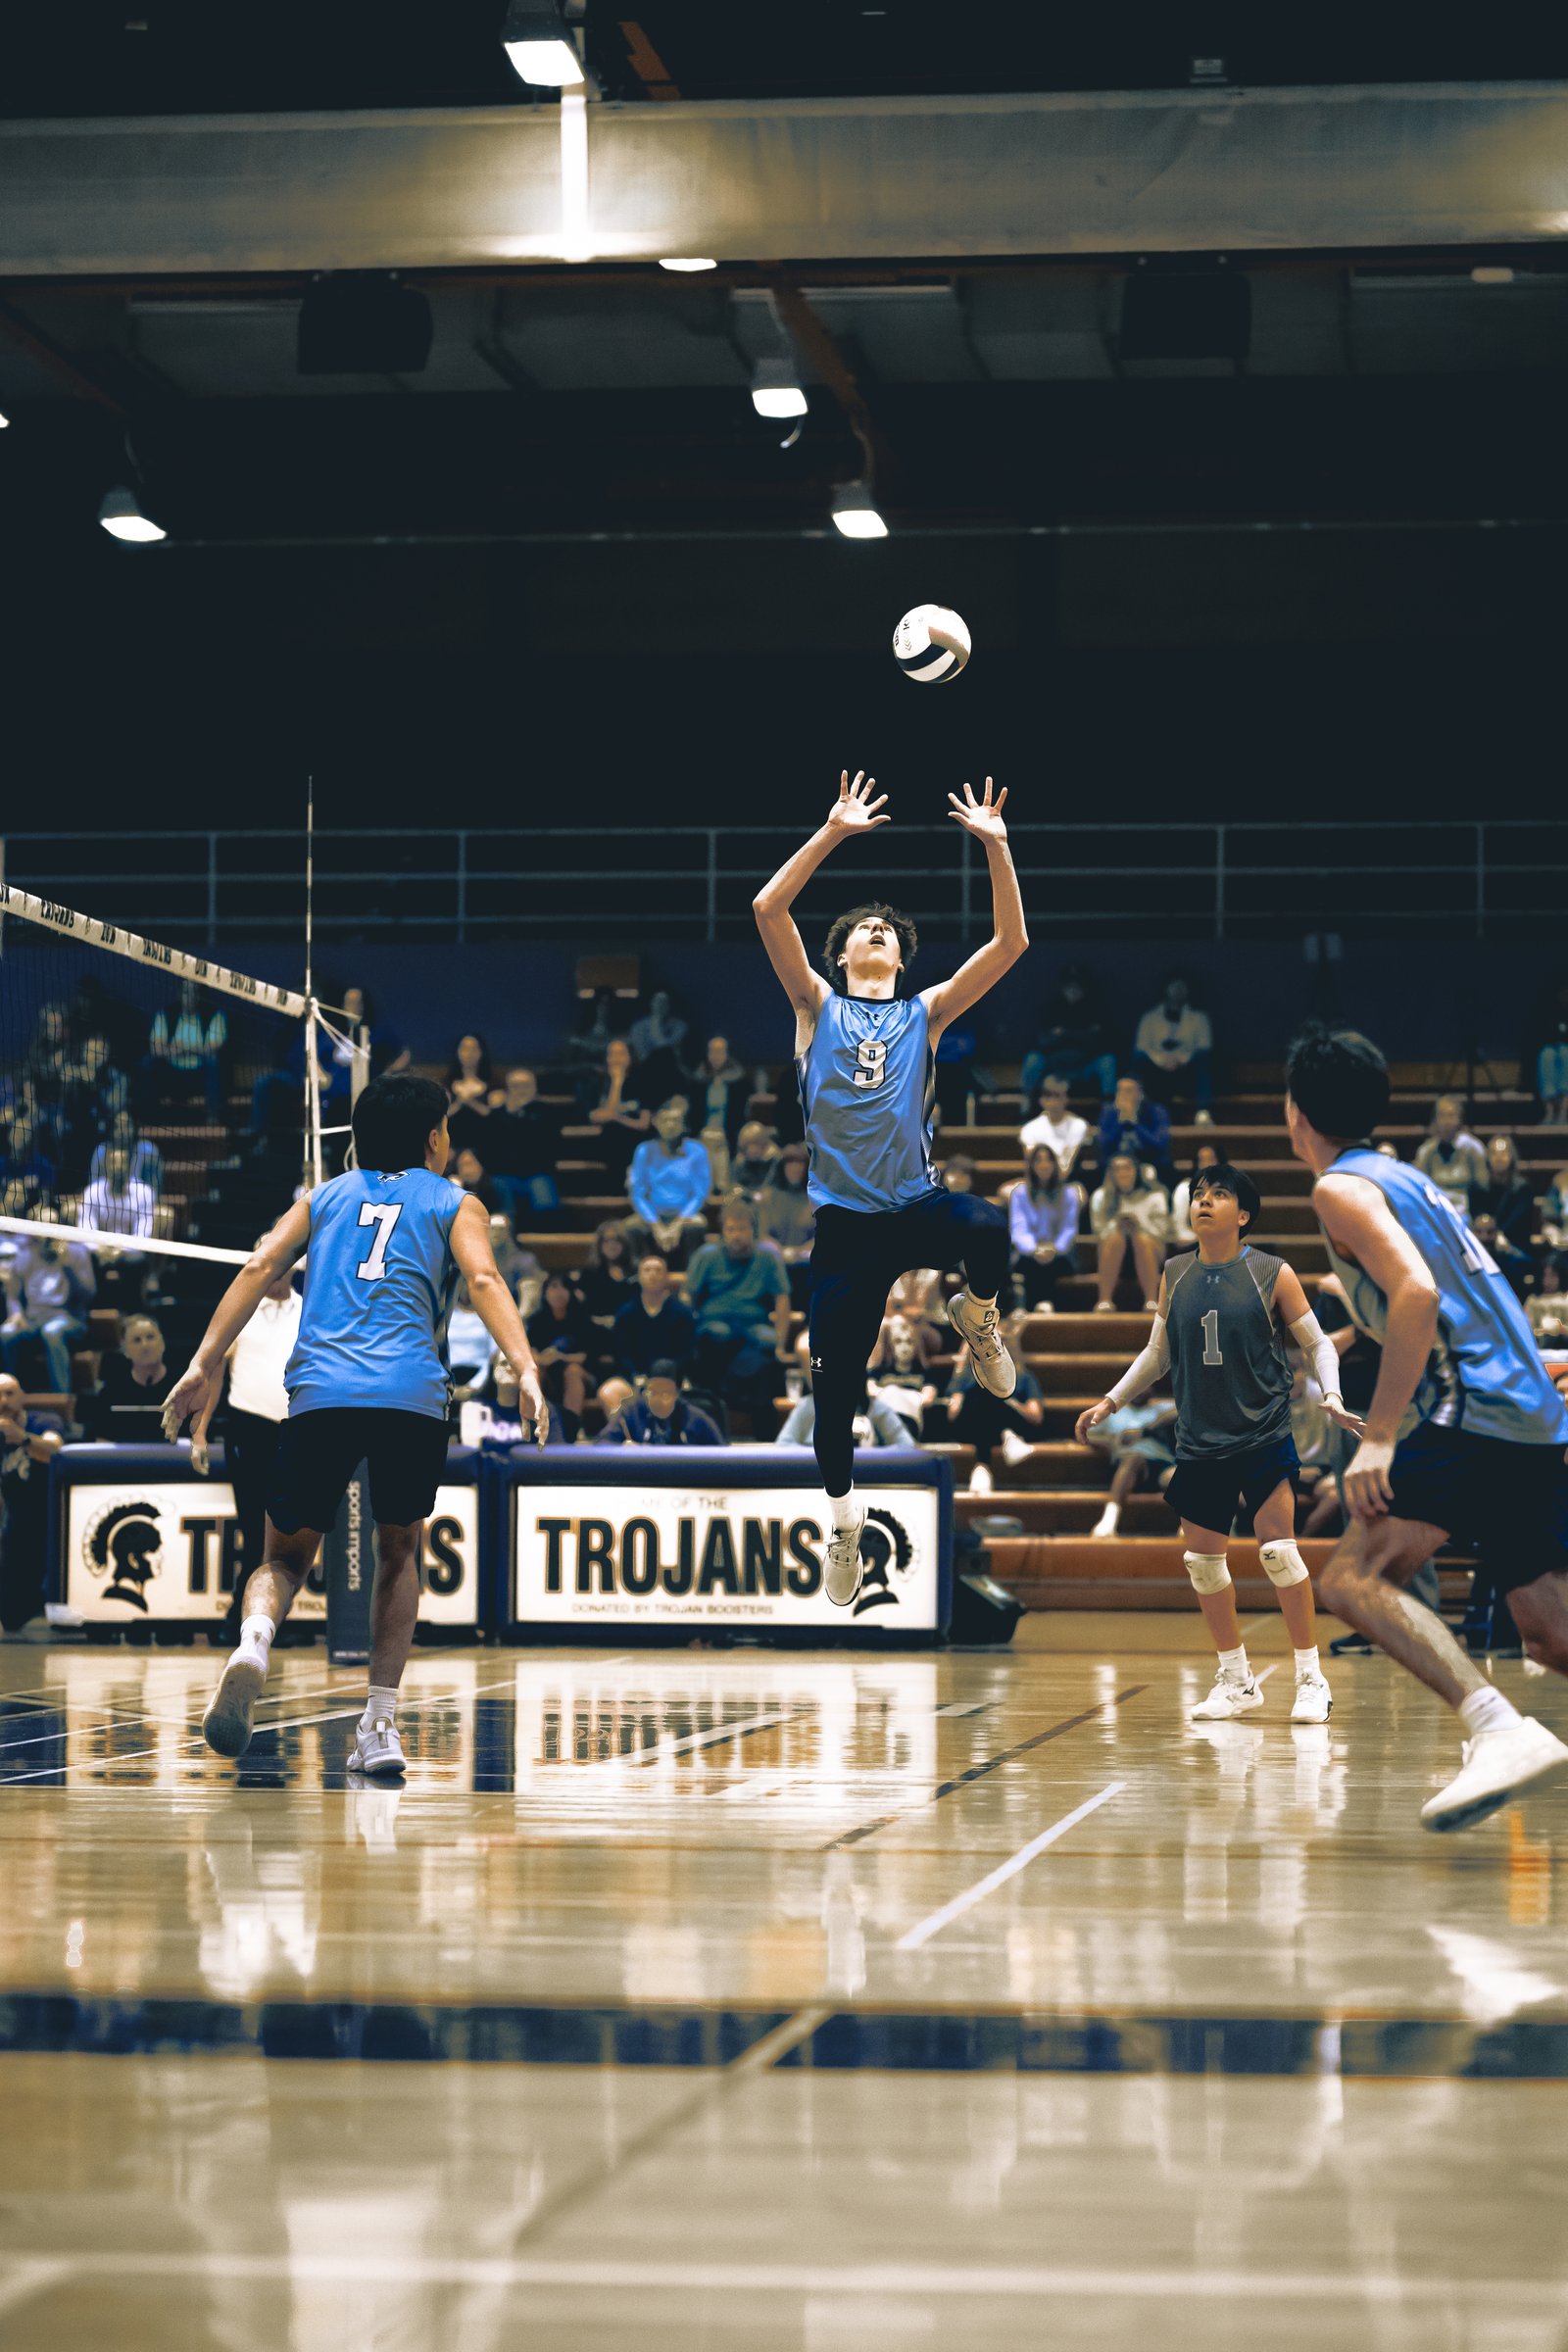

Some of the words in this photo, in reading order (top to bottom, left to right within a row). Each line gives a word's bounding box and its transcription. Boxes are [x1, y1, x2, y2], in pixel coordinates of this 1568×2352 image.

[854, 1039, 888, 1090] 9
[356, 1201, 404, 1282] 7
[1200, 1309, 1223, 1365] 1
[698, 1495, 727, 1510] THE
[537, 1516, 823, 1596] TROJANS
[706, 1603, 774, 1615] BOOSTERS
